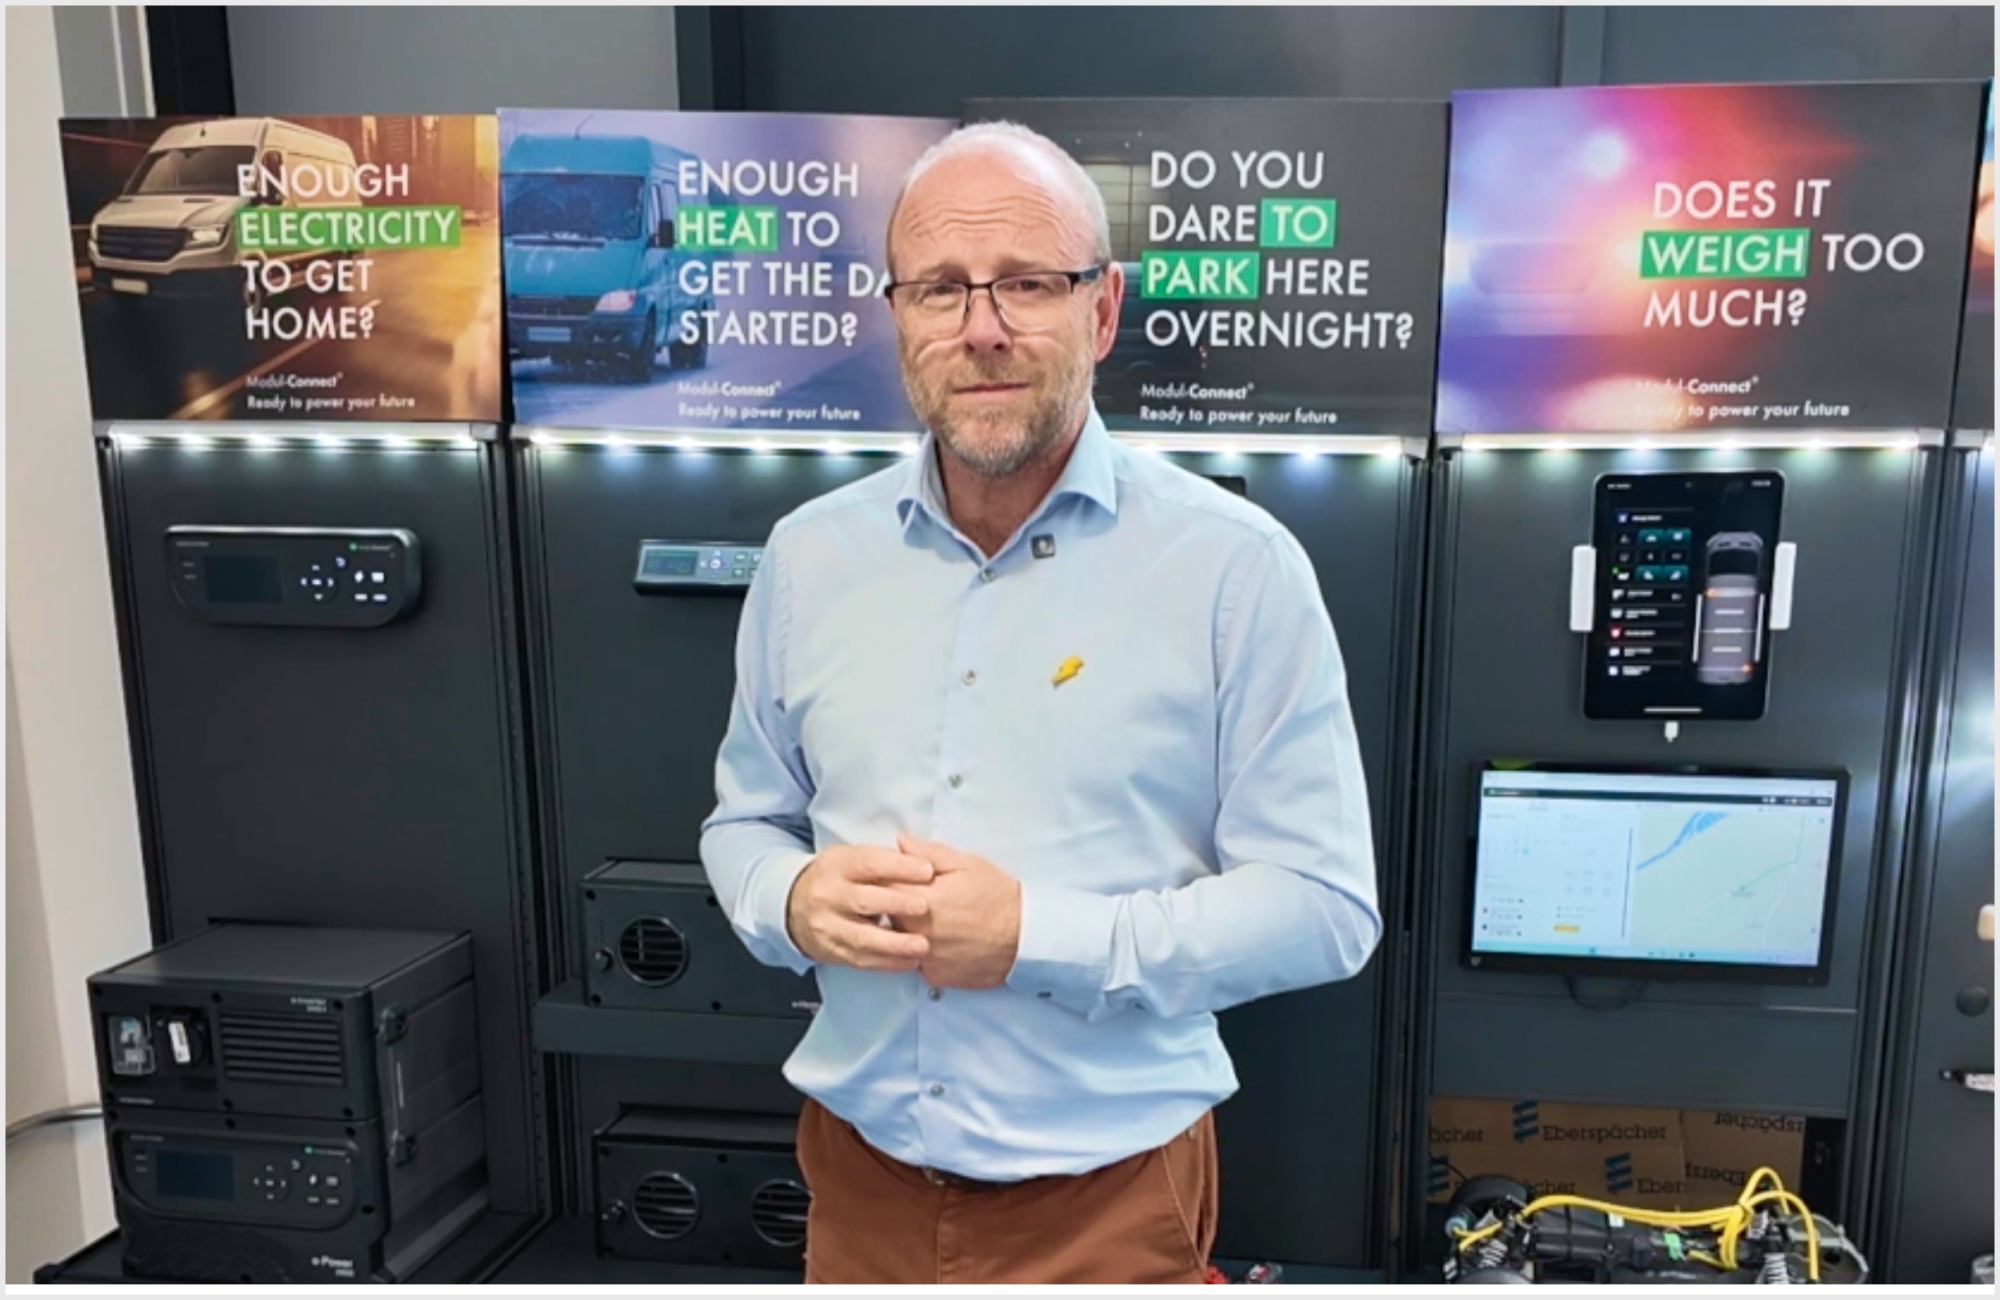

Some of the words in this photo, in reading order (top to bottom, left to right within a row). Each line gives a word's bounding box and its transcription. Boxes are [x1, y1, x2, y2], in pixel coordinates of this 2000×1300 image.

[237, 163, 409, 197] ENOUGH
[678, 160, 859, 197] ENOUGH
[1151, 150, 1217, 189] DO
[1231, 150, 1325, 189] YOU
[1652, 180, 1777, 220] DOES
[1793, 178, 1832, 218] IT
[240, 209, 456, 247] ELECTRICITY
[678, 210, 775, 247] HEAT
[787, 211, 840, 248] TO
[1148, 204, 1257, 242] DARE
[1271, 205, 1329, 242] TO
[1647, 234, 1806, 275] WEIGH
[1822, 232, 1925, 272] TOO
[242, 260, 291, 294] TO
[305, 260, 373, 294] GET
[679, 261, 751, 297] GET
[763, 262, 832, 297] THE
[848, 262, 892, 298] DA
[1147, 258, 1251, 295] PARK
[1266, 258, 1370, 295] HERE
[246, 306, 374, 340] HOME?
[1643, 287, 1808, 329] MUCH?
[679, 310, 858, 347] STARTED?
[1145, 309, 1415, 350] OVERNIGHT?
[246, 394, 286, 412] Ready
[290, 396, 303, 409] to
[305, 397, 344, 412] power
[347, 397, 376, 412] your
[379, 393, 416, 408] future
[678, 402, 720, 420] Ready
[723, 405, 738, 418] to
[741, 406, 783, 421] power
[786, 407, 817, 422] your
[821, 403, 862, 421] future
[1139, 404, 1185, 425] Ready
[1189, 407, 1204, 421] to
[1207, 410, 1254, 426] power
[1257, 410, 1292, 426] your
[1294, 406, 1338, 424] future
[1687, 404, 1704, 417] to
[1707, 404, 1759, 421] power
[1763, 404, 1800, 421] your
[1802, 399, 1851, 418] future
[1542, 1123, 1667, 1144] Eberspächer
[1637, 1178, 1687, 1194] Eber
